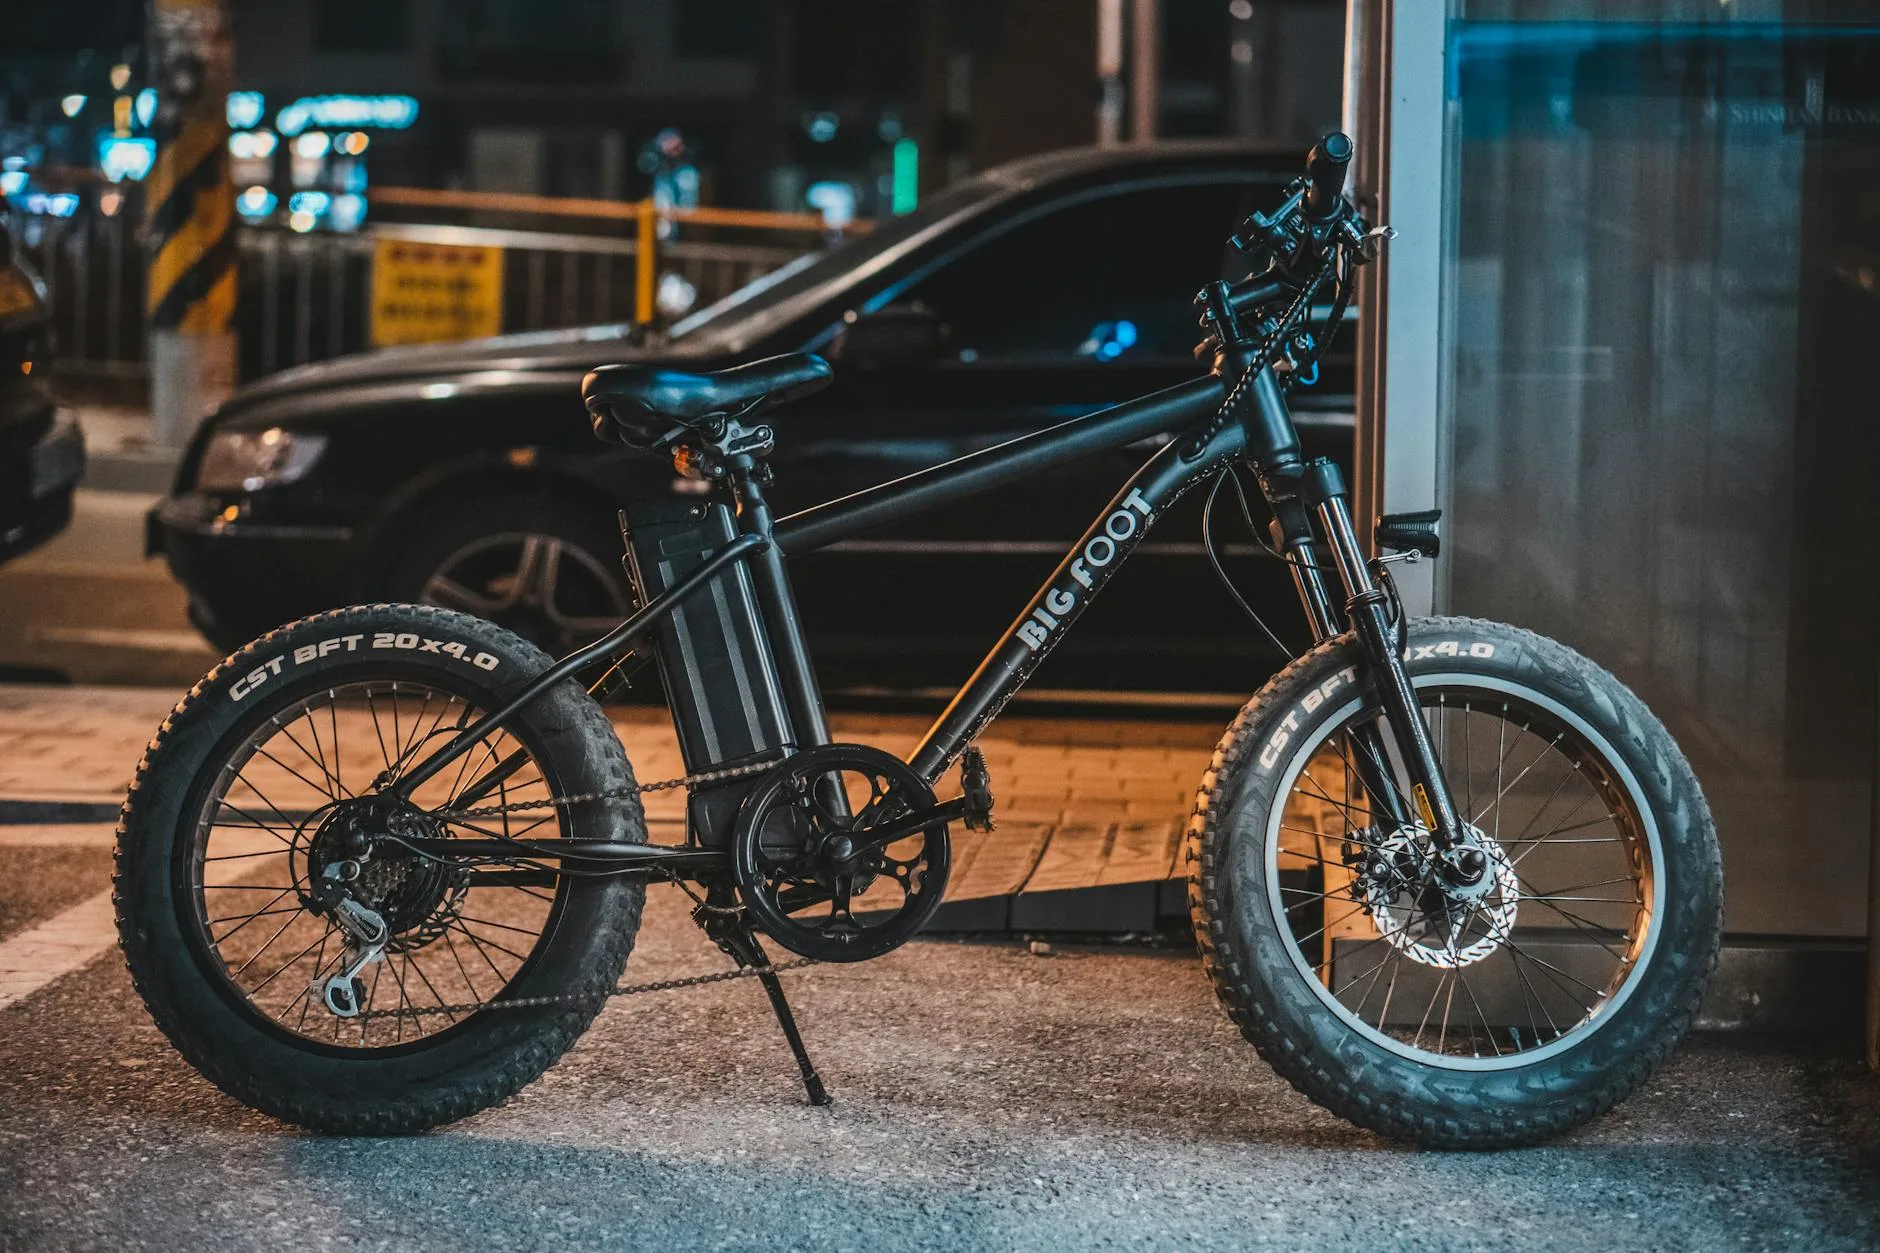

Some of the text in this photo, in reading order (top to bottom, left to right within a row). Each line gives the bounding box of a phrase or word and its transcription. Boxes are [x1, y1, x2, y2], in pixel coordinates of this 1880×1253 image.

[1015, 487, 1152, 651] BIG FOOT
[228, 632, 500, 702] CST BFT 20x4.0
[1259, 709, 1300, 769] CST
[1300, 664, 1358, 714] BFT
